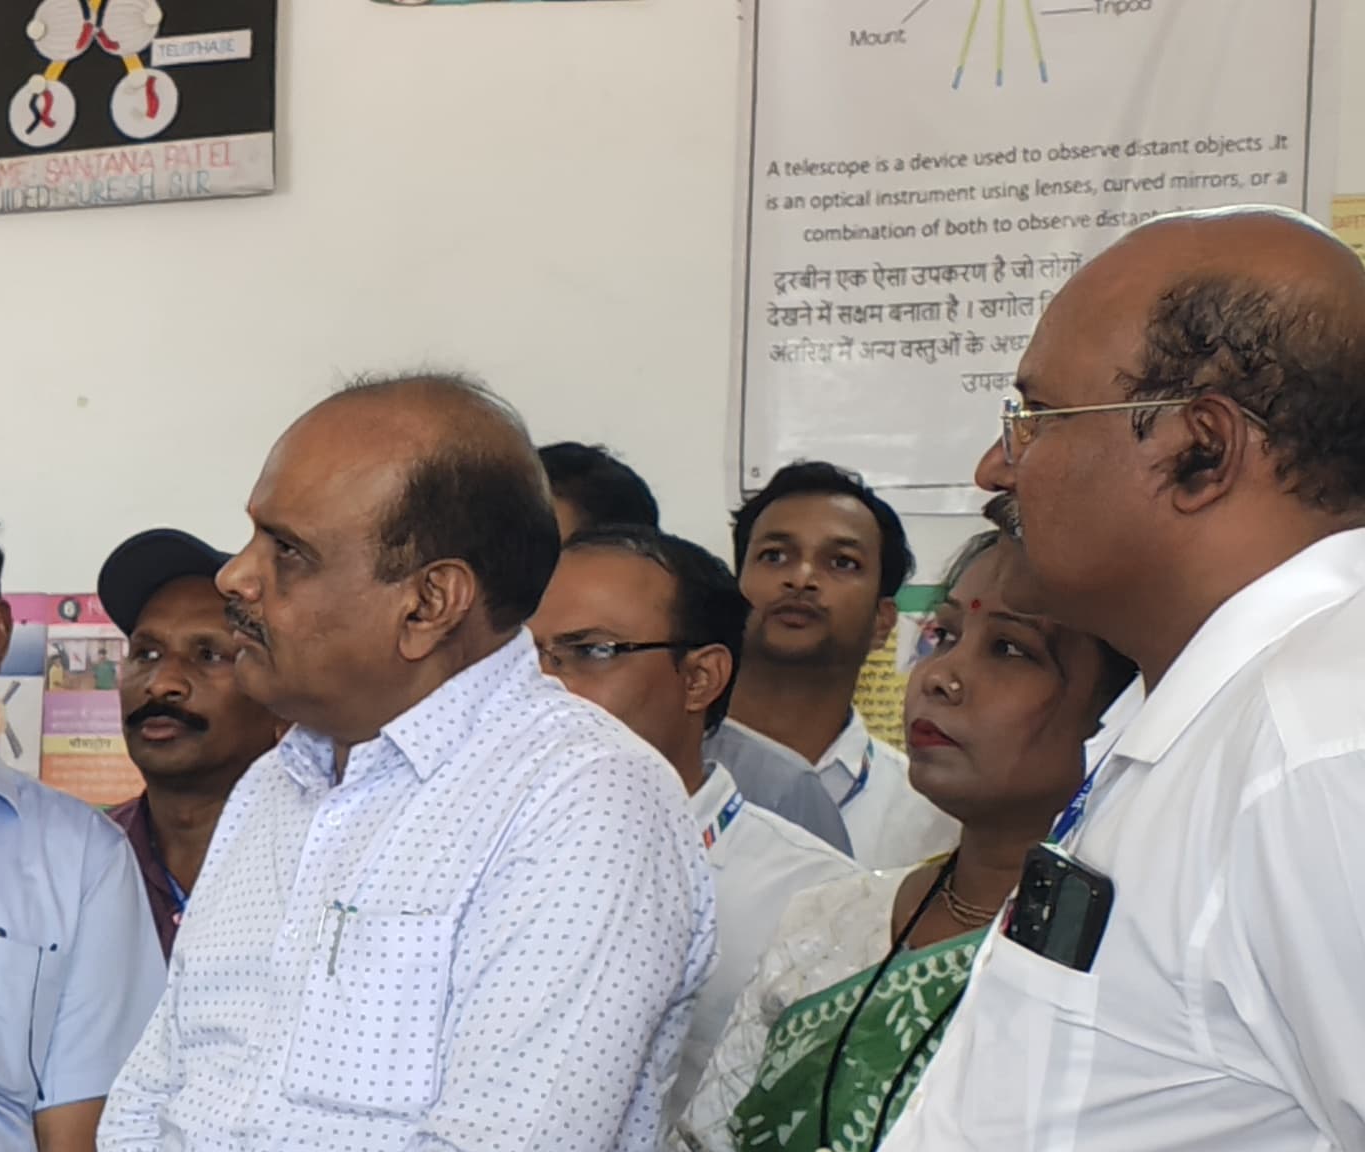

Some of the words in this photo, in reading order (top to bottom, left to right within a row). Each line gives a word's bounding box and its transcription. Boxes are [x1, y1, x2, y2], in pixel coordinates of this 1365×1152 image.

[849, 28, 907, 47] Mount
[767, 161, 780, 177] A
[785, 157, 870, 178] telescope
[875, 158, 889, 173] is
[893, 158, 905, 171] a
[910, 151, 968, 171] device
[974, 146, 1017, 167] used
[1022, 148, 1042, 163] to
[1047, 143, 1119, 162] observe
[1124, 138, 1189, 157] distant
[1195, 135, 1262, 158] objects
[765, 194, 778, 210] is
[783, 194, 806, 209] an
[810, 190, 871, 211] optical
[875, 185, 975, 205] instrument
[981, 180, 1030, 201] using
[1035, 178, 1097, 196] lenses,
[1103, 173, 1165, 192] curved
[1170, 171, 1244, 189] mirrors,
[1250, 171, 1270, 186] or
[1276, 171, 1287, 185] a
[803, 222, 916, 242] combination
[921, 218, 941, 237] of
[945, 216, 988, 236] both
[993, 217, 1012, 233] to
[1017, 212, 1090, 231] observe
[835, 266, 867, 291] एक
[873, 261, 906, 289] ऐसा
[911, 262, 988, 286] उपकरण
[992, 254, 1006, 284] है
[1011, 254, 1035, 280] जो
[767, 302, 812, 327] देखने
[818, 300, 832, 326] में
[889, 299, 941, 323] बनाता
[946, 293, 960, 322] है
[838, 335, 854, 361] में
[859, 339, 895, 361] अन्य
[965, 330, 985, 355] के
